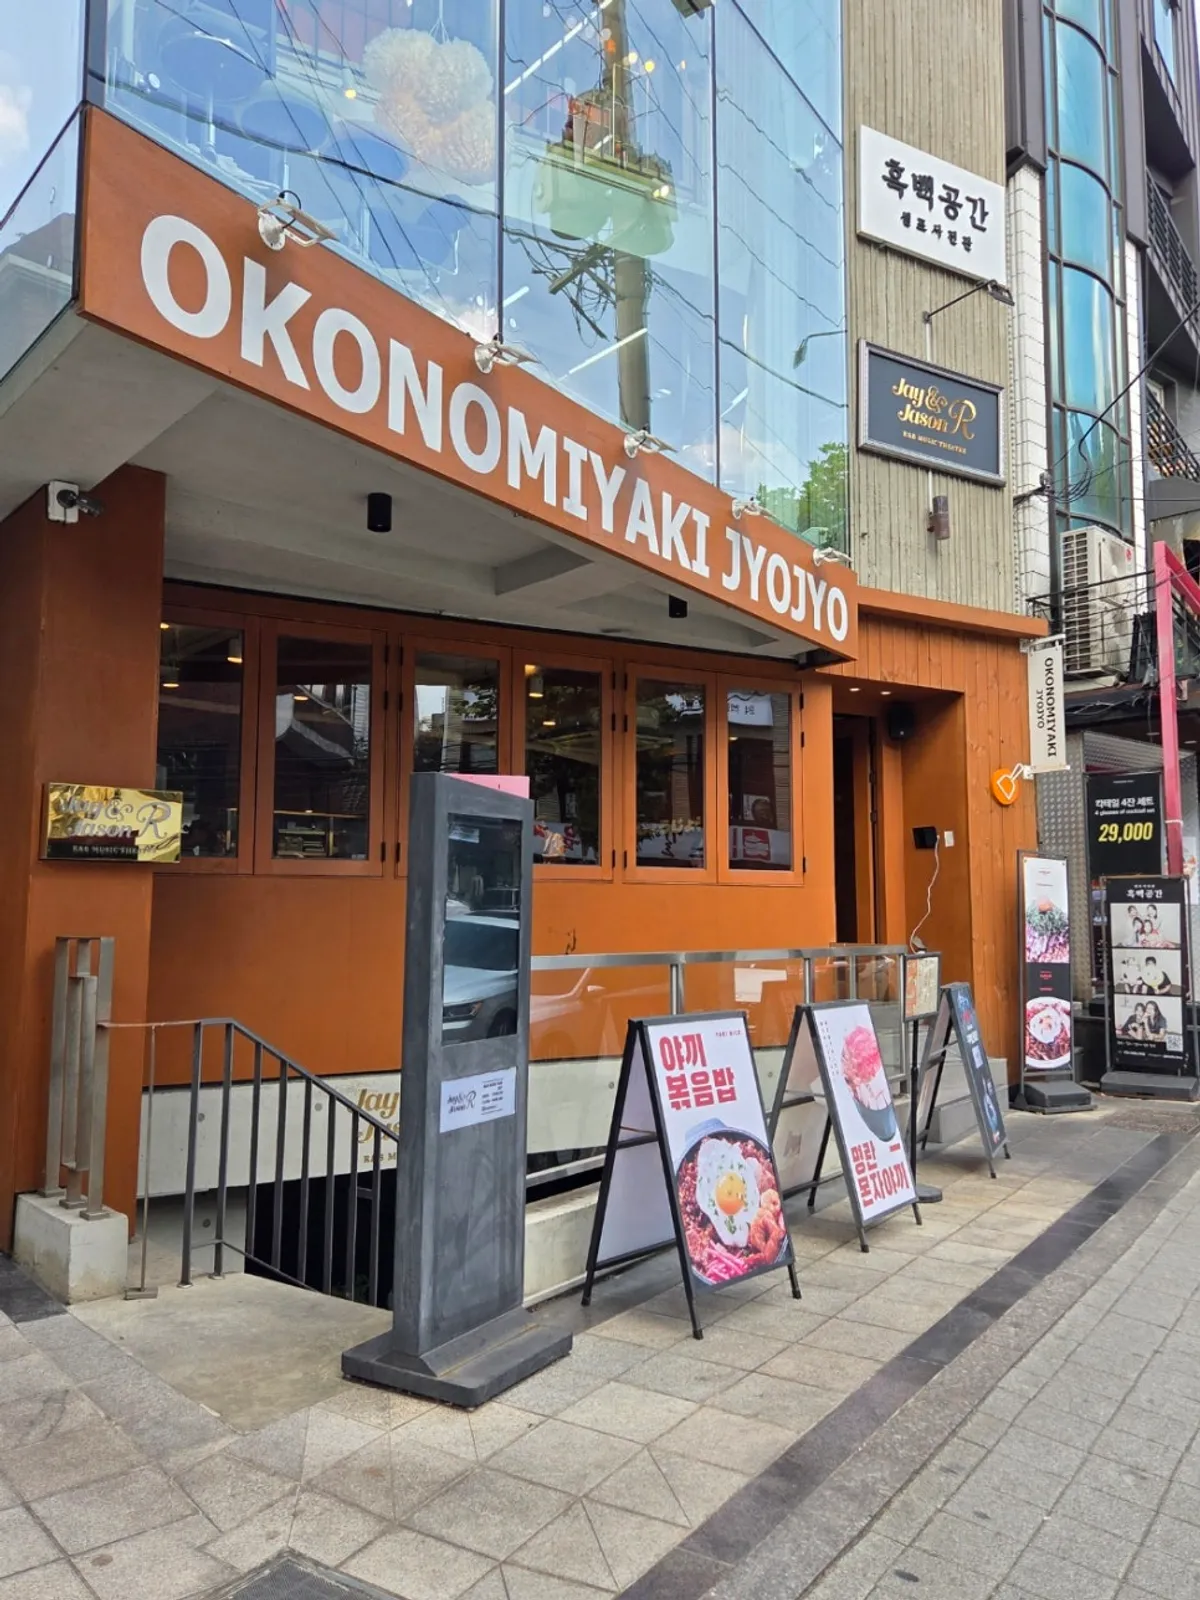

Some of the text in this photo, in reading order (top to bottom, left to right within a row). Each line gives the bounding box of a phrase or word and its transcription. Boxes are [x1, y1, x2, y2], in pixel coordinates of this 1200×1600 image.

[881, 158, 989, 233] 흑백공간
[140, 214, 848, 642] OKONOMIYAKI JYOJYO
[897, 399, 977, 440] Jason R
[1036, 689, 1045, 729] JYOJYO
[1044, 657, 1057, 757] OKONOMIYAKI
[64, 801, 172, 840] Jason R
[1098, 822, 1154, 844] 29,000
[659, 1033, 708, 1072] 야끼
[665, 1066, 737, 1111] 볶음밥
[850, 1140, 878, 1176] 명란
[857, 1161, 910, 1208] 몬자야끼
